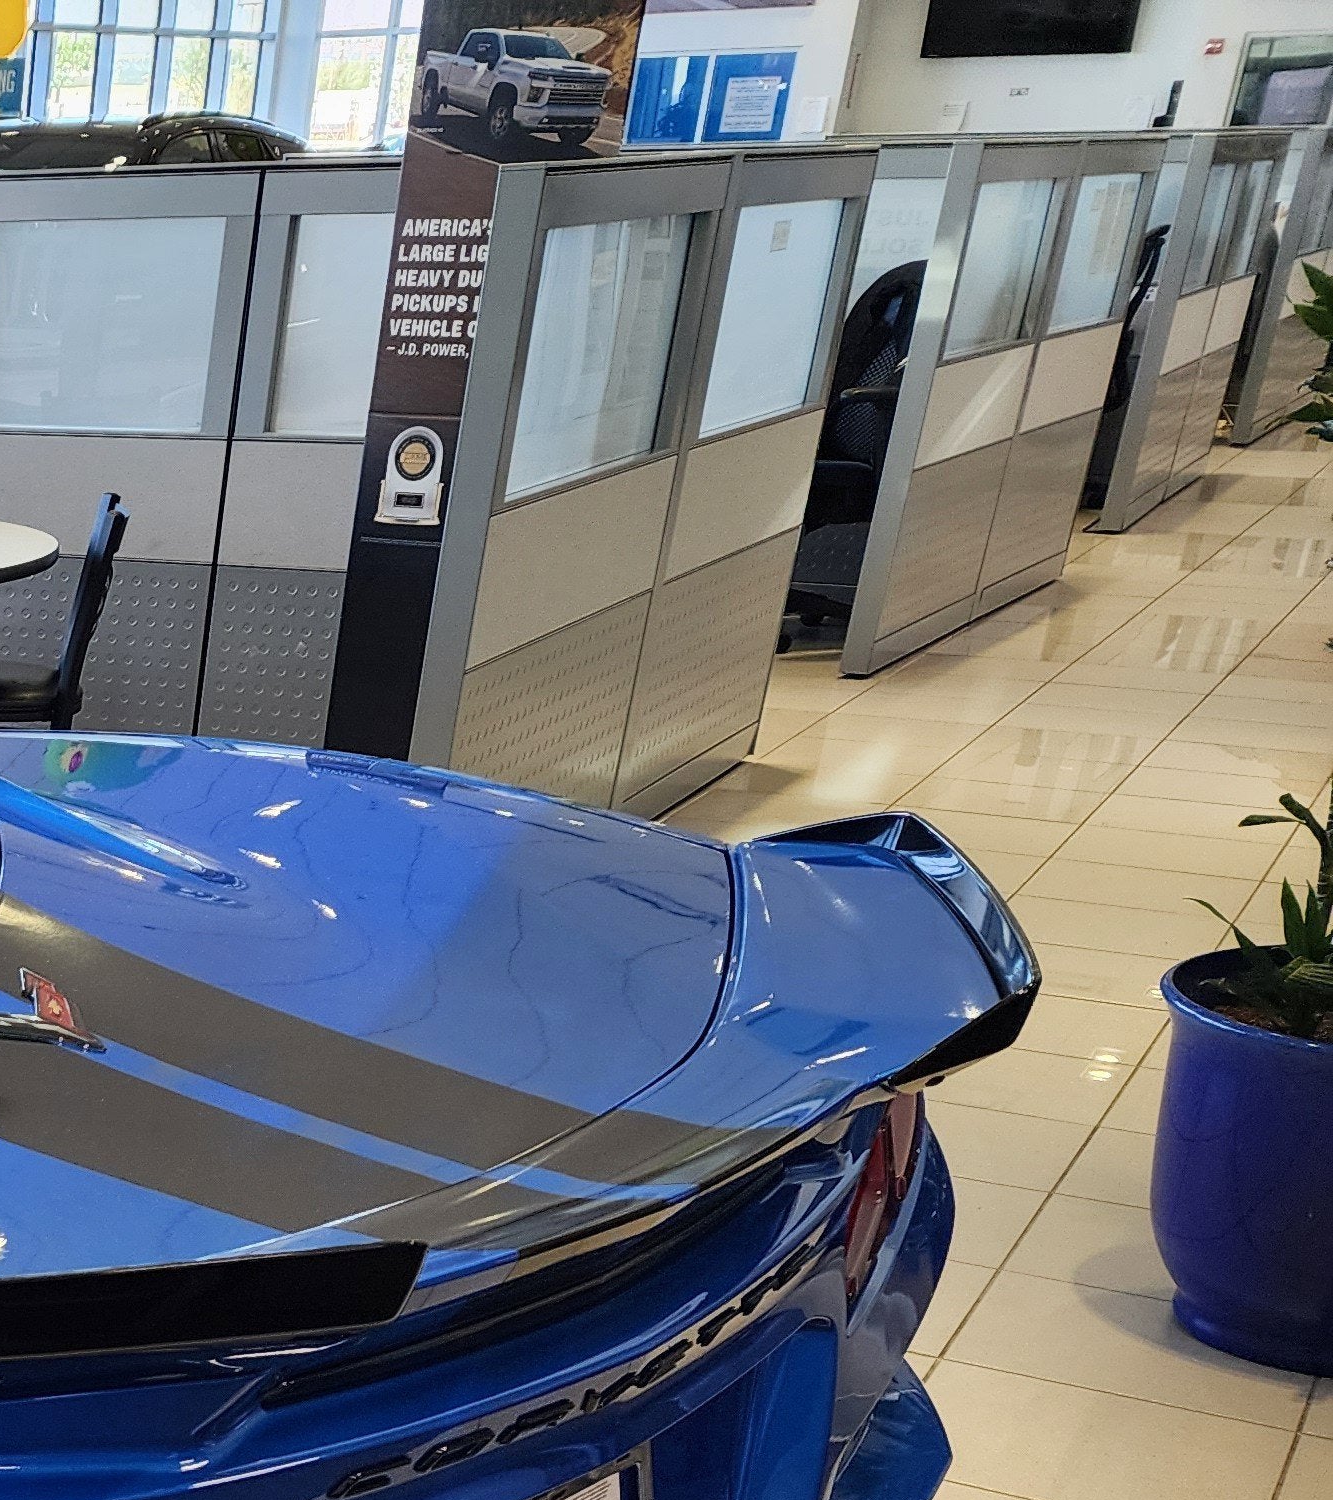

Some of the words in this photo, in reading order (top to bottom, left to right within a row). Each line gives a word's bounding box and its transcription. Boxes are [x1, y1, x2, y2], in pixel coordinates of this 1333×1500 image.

[398, 244, 457, 263] LARGE
[459, 244, 489, 263] LIG
[394, 269, 455, 288] HEAVY
[457, 269, 484, 288] DU
[390, 294, 469, 313] PICKUPS
[389, 318, 464, 338] VEHICLE
[397, 343, 420, 356] J.D.
[422, 343, 470, 359] POWER,
